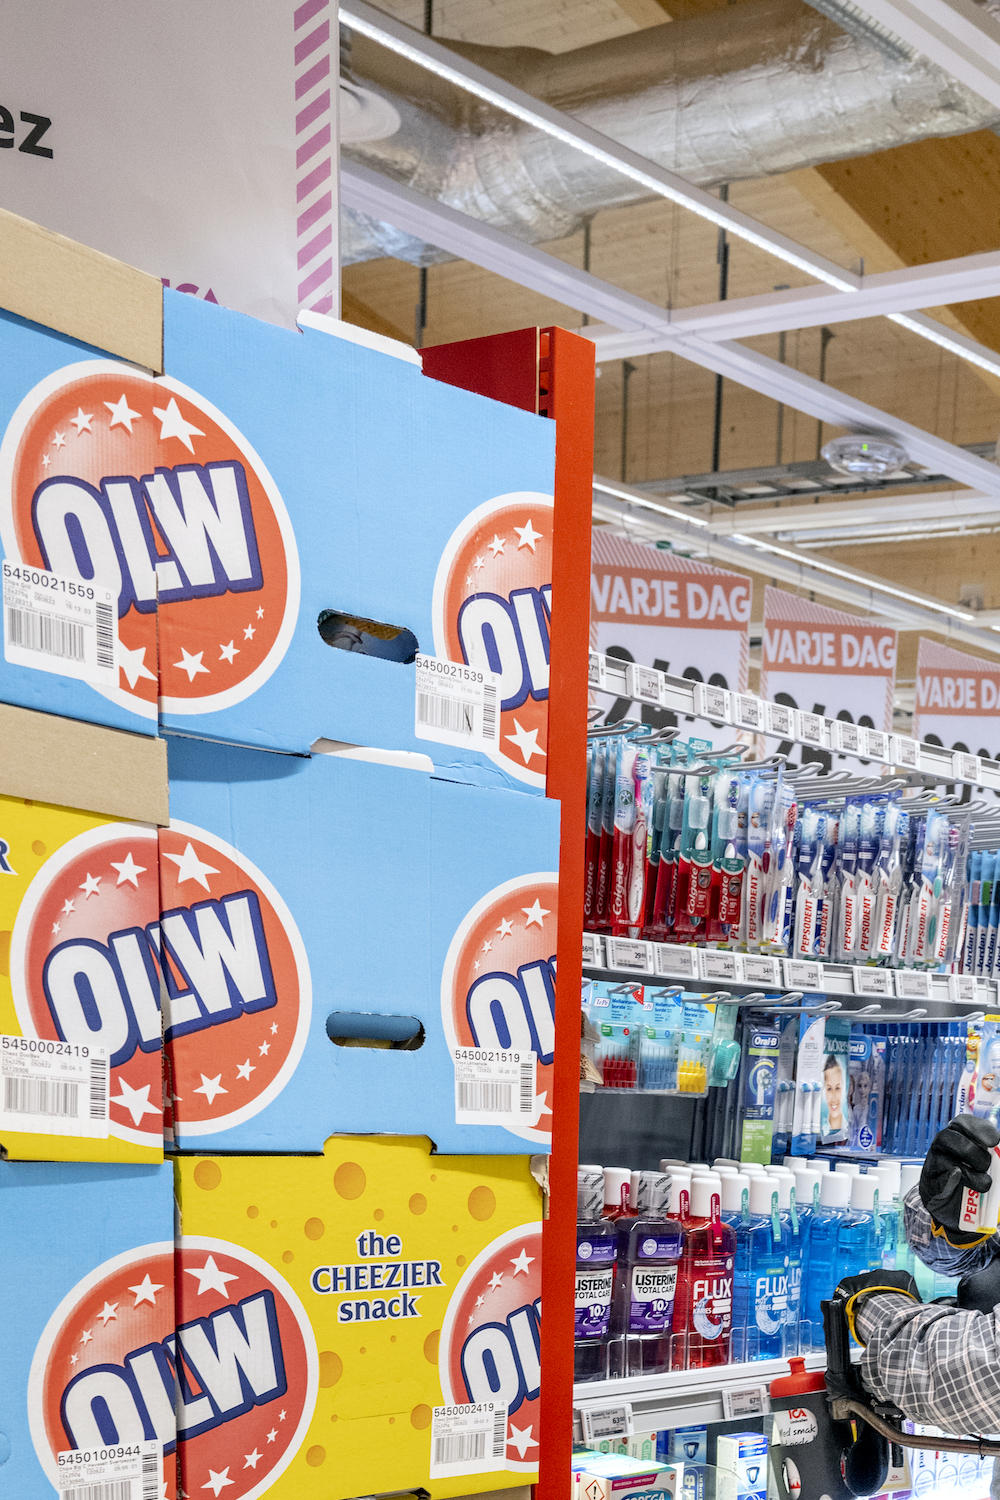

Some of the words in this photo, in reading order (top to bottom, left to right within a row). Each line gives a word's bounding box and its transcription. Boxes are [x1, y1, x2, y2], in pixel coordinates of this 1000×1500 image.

[34, 463, 262, 612] OLW
[4, 564, 95, 600] 5450021559
[591, 574, 681, 619] VARJE
[686, 582, 750, 622] DAG
[459, 587, 552, 706] OL
[764, 628, 836, 667] VARJE
[840, 634, 896, 669] DAG
[416, 658, 484, 684] 5450021539
[916, 674, 978, 710] VARJE
[584, 862, 594, 915] Colgate
[613, 861, 624, 915] Colgate
[687, 868, 698, 914] Colgate
[719, 876, 729, 922] Colgate
[749, 875, 758, 940] PEPSODENT
[801, 899, 813, 953] PEPSODENT
[844, 897, 853, 951] PEPSODENT
[861, 897, 871, 951] PEPSODENT
[881, 896, 894, 951] PEPSODENT
[916, 898, 928, 957] PEPSODENT
[938, 906, 951, 958] PEPSODENT
[965, 933, 974, 972] Jordan
[977, 933, 986, 972] Jordan
[985, 933, 996, 972] Jordan
[45, 891, 276, 1064] OLW
[468, 958, 556, 1062] OL
[2, 1037, 89, 1058] 5450002419
[455, 1050, 520, 1063] 5450021519
[754, 1036, 777, 1046] Oral-B
[357, 1231, 402, 1257] the
[313, 1261, 444, 1294] CHEEZIER
[598, 1290, 611, 1298] CARE
[636, 1274, 676, 1286] LISTERINE
[637, 1286, 660, 1294] TOTAL
[661, 1285, 675, 1293] CARE
[693, 1278, 733, 1300] FLUX
[755, 1275, 789, 1298] FLUX
[339, 1294, 420, 1323] snack
[62, 1291, 287, 1453] OLW
[462, 1301, 541, 1413] OL
[434, 1403, 494, 1418] 5450002419
[788, 1408, 807, 1420] ICA
[793, 1424, 816, 1436] smak
[58, 1446, 141, 1466] 5450100944
